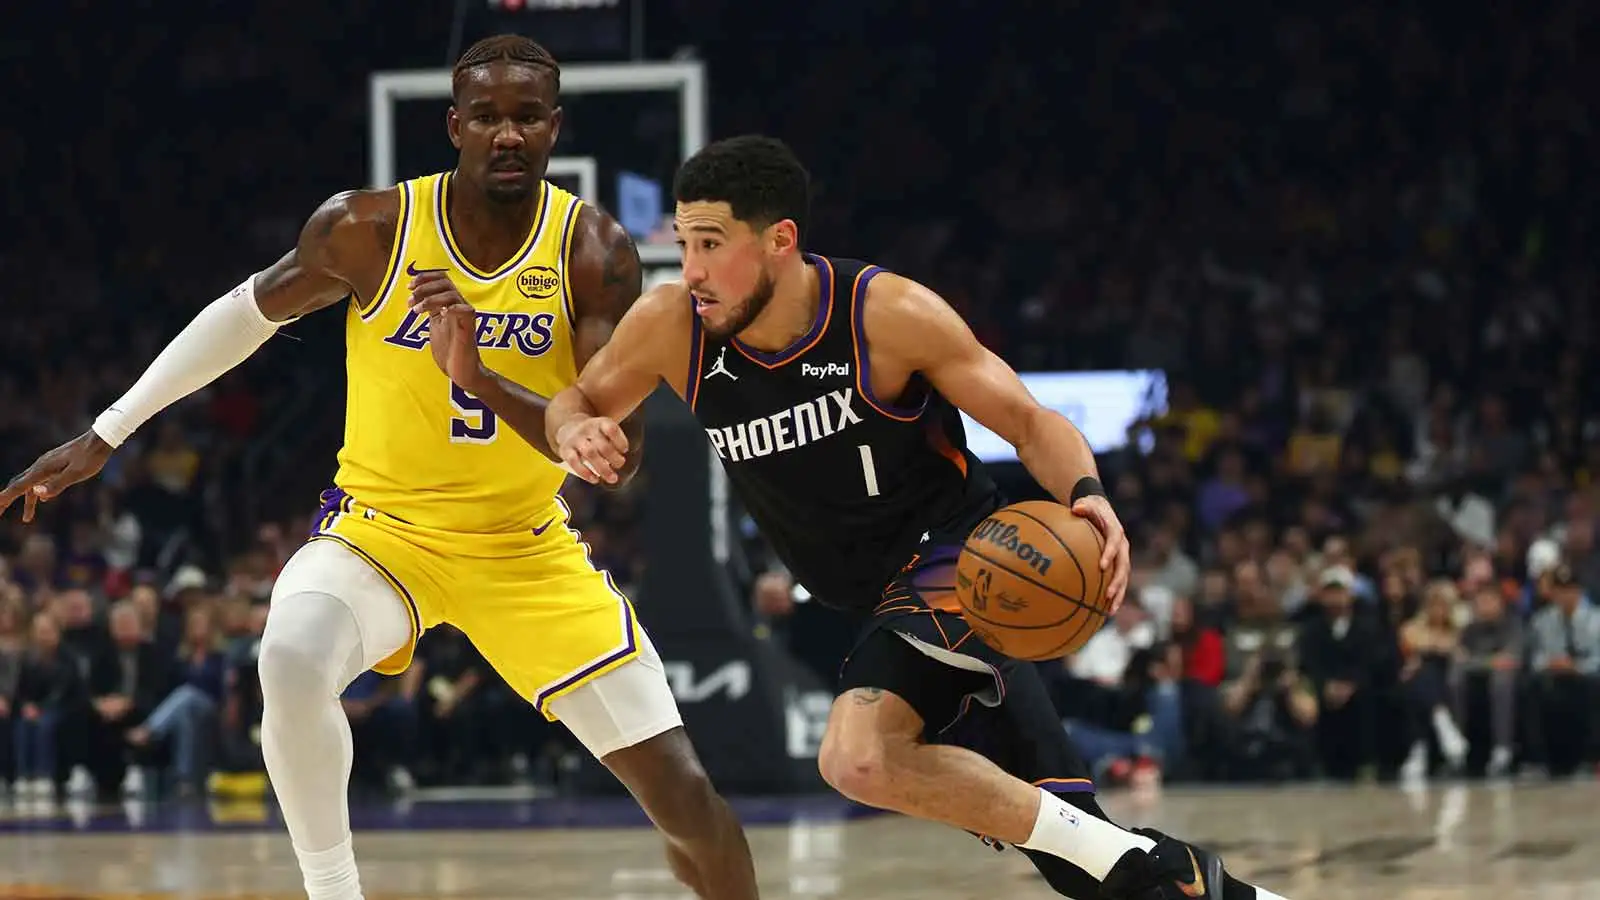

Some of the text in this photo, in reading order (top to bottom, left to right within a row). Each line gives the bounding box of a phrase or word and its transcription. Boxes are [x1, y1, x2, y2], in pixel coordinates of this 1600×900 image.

[521, 274, 558, 290] bibigo
[384, 308, 555, 358] LAERS
[802, 362, 849, 380] PayPal
[705, 387, 864, 463] PHOENIX
[857, 444, 880, 497] 1
[973, 518, 1052, 576] Wilson
